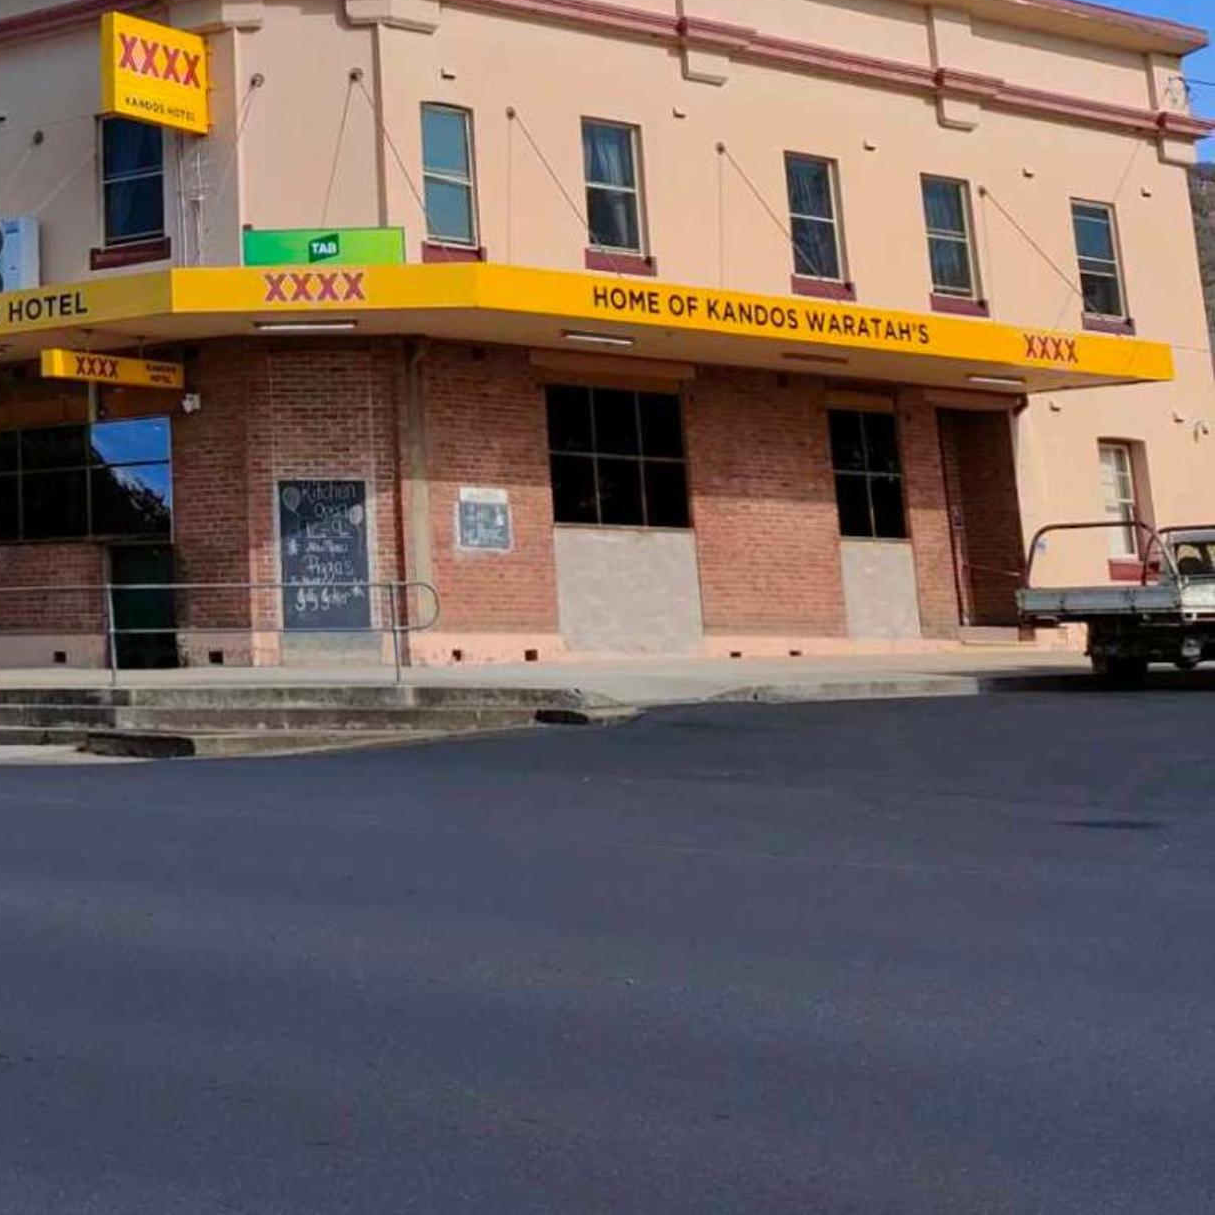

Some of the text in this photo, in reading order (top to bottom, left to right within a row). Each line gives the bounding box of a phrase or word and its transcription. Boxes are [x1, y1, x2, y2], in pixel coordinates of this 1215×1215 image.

[118, 32, 201, 89] XXXX
[126, 96, 196, 122] KANDOS HOTEL
[311, 242, 337, 254] TAB
[264, 272, 365, 302] XXXX
[8, 291, 88, 324] HOTEL
[593, 286, 930, 344] HOME OF KANDOS WARATAH'S
[1024, 334, 1078, 363] XXXX
[76, 355, 118, 379] XXXX
